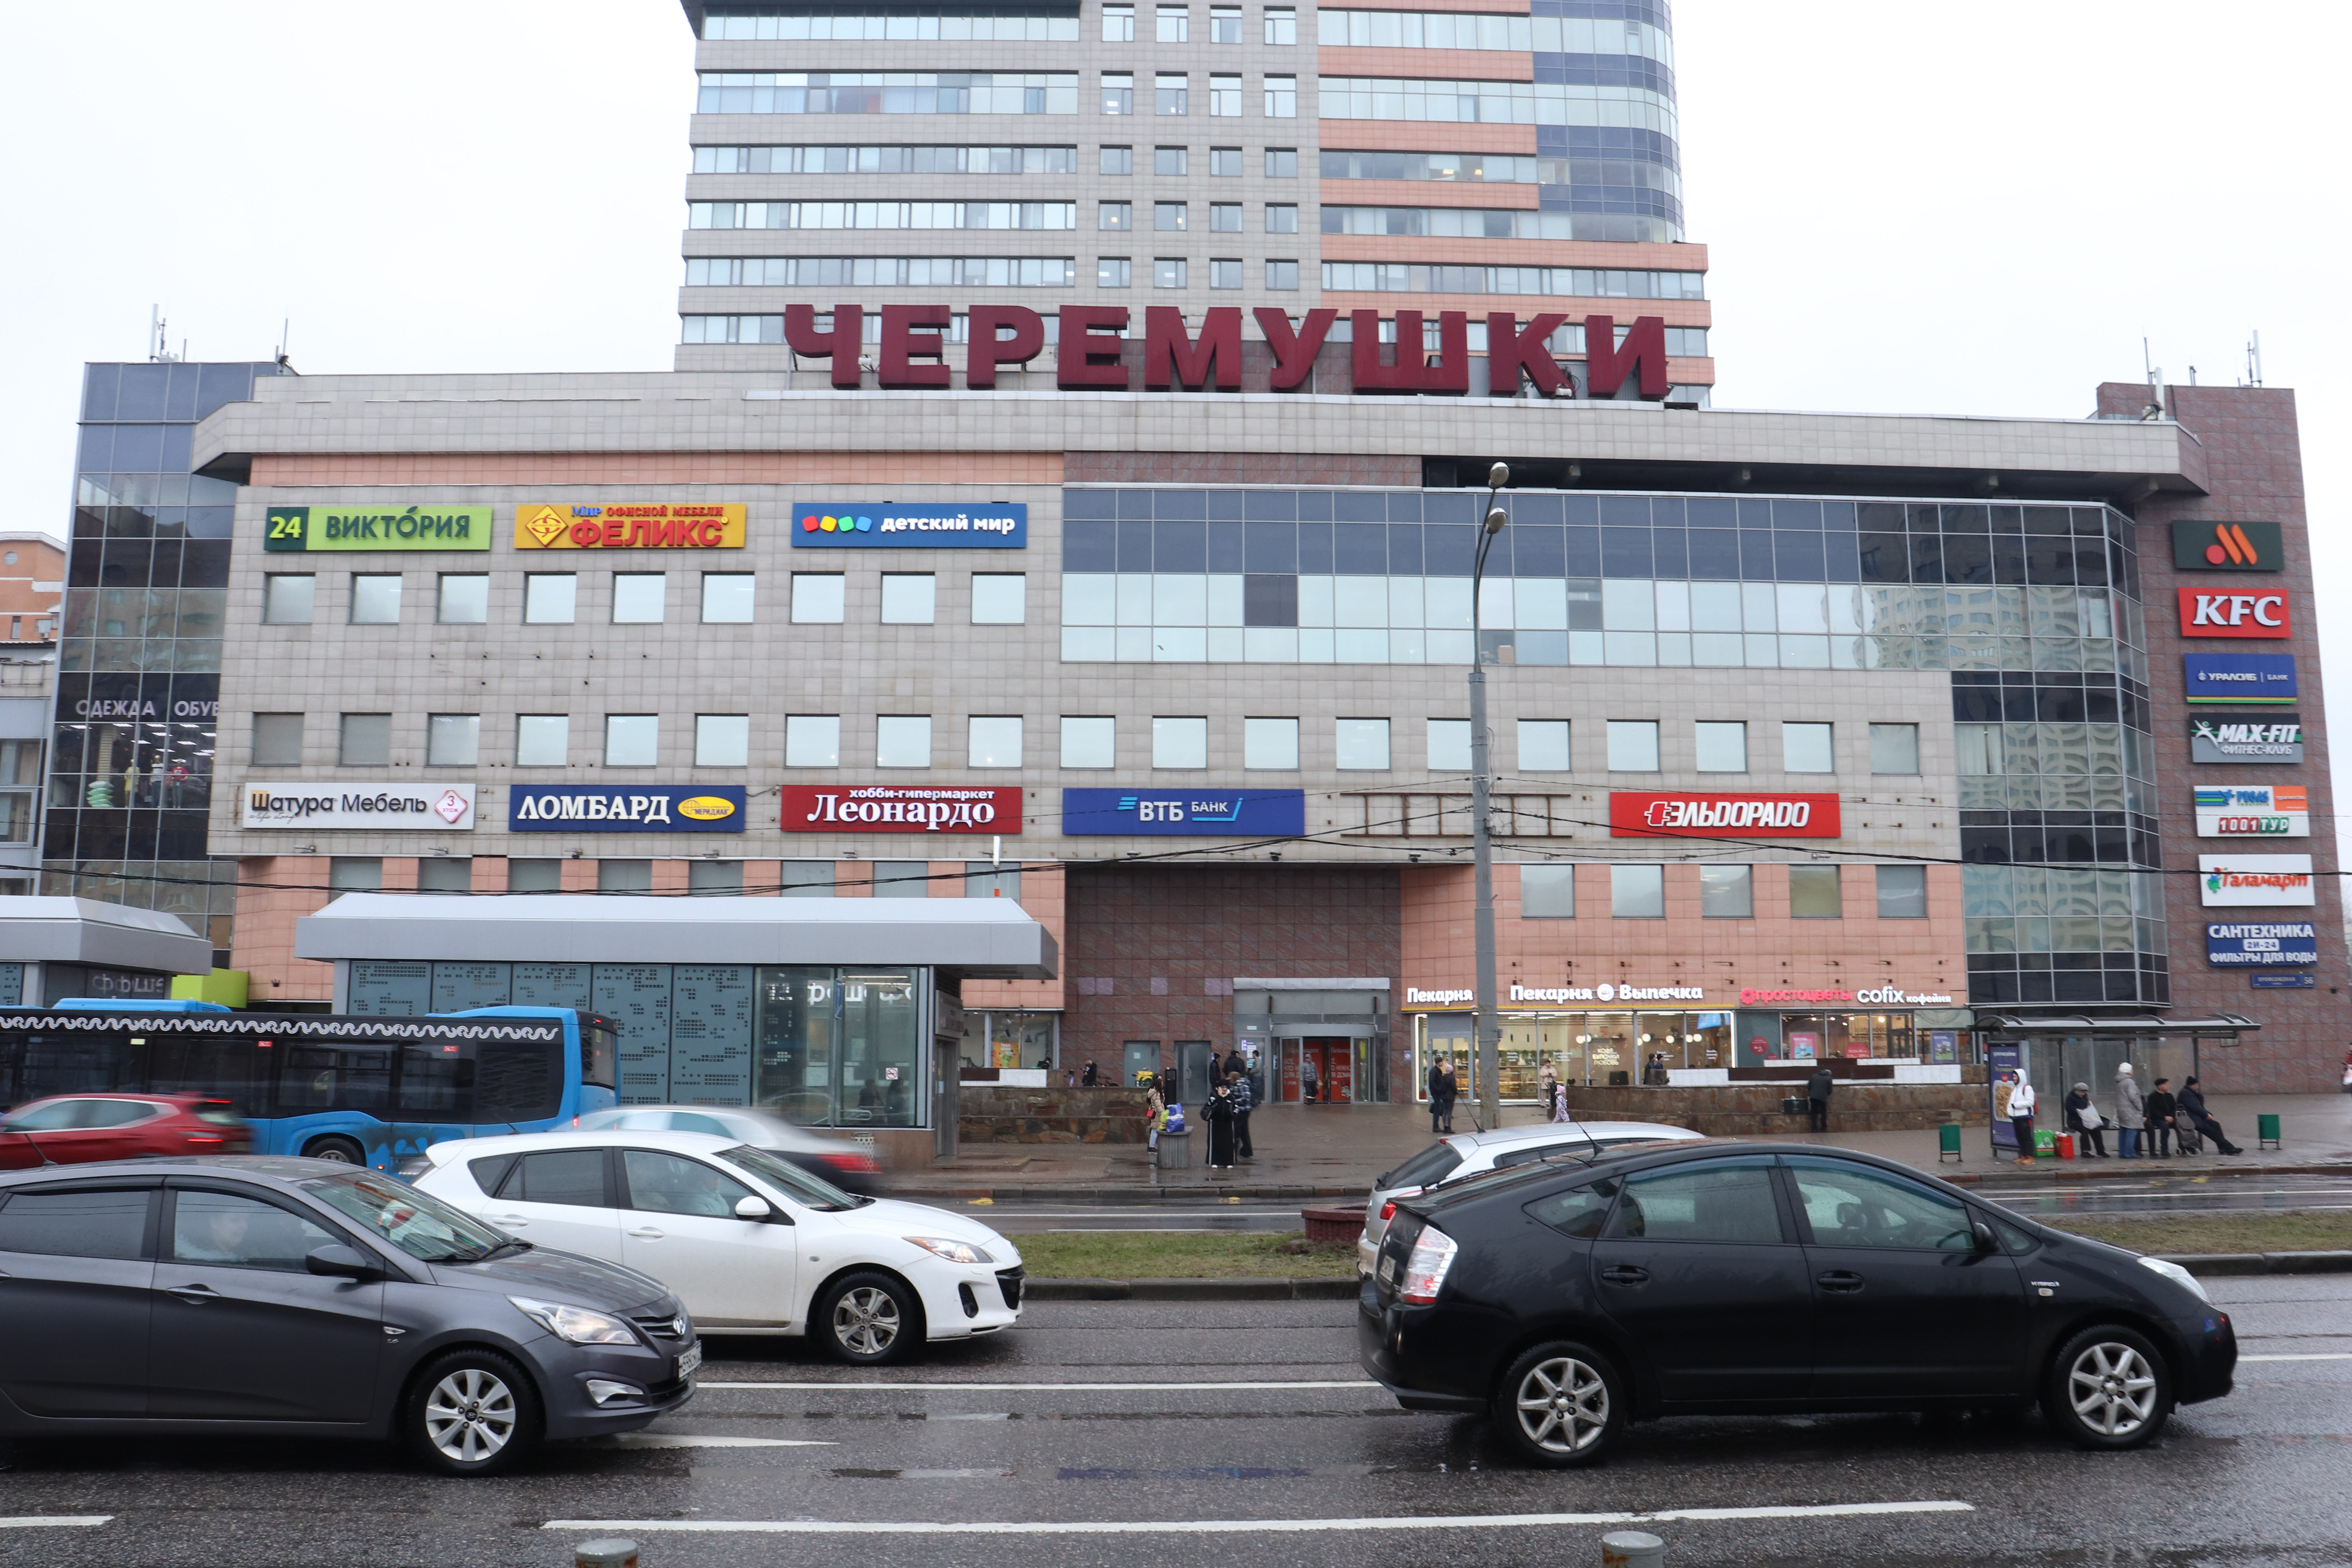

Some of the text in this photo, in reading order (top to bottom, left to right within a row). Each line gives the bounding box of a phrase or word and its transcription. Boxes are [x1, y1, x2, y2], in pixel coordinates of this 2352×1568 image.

[785, 304, 1668, 401] ЧЕРЕМУШКИ
[606, 505, 668, 517] ОФИСНОЙ
[673, 506, 723, 516] МЕБЕЛИ
[269, 516, 302, 539] 24
[326, 506, 470, 538] ВИКТОРИЯ
[880, 514, 1016, 535] детский мир
[570, 519, 722, 547] ФЕЛИКС
[2192, 595, 2282, 626] KFC
[2208, 673, 2257, 681] УРАЛСИБ
[76, 699, 156, 719] ОДЕЖДА
[2217, 724, 2300, 743] MAX-FIT
[2221, 745, 2293, 755] ФИТНЕС-КЛУБ
[251, 790, 427, 817] Шатура Мебель
[447, 796, 455, 806] 3
[849, 788, 995, 801] хобби-гипермаркет
[517, 795, 671, 824] ЛОМБАРД
[807, 794, 995, 830] Леонардо
[1139, 801, 1229, 822] ВТБ БАНК
[2209, 924, 2315, 938] САНТЕХНИКА
[2210, 952, 2318, 964] ФИЛЬТРЫ ДЛЯ ВОДЫ
[1407, 987, 1474, 1005] Пекарня
[1510, 984, 1704, 1004] Пекарня Выпечка
[1755, 989, 1853, 1003] простоцветы
[1857, 985, 1905, 1004] cofix
[1906, 993, 1952, 1005] кофейня
